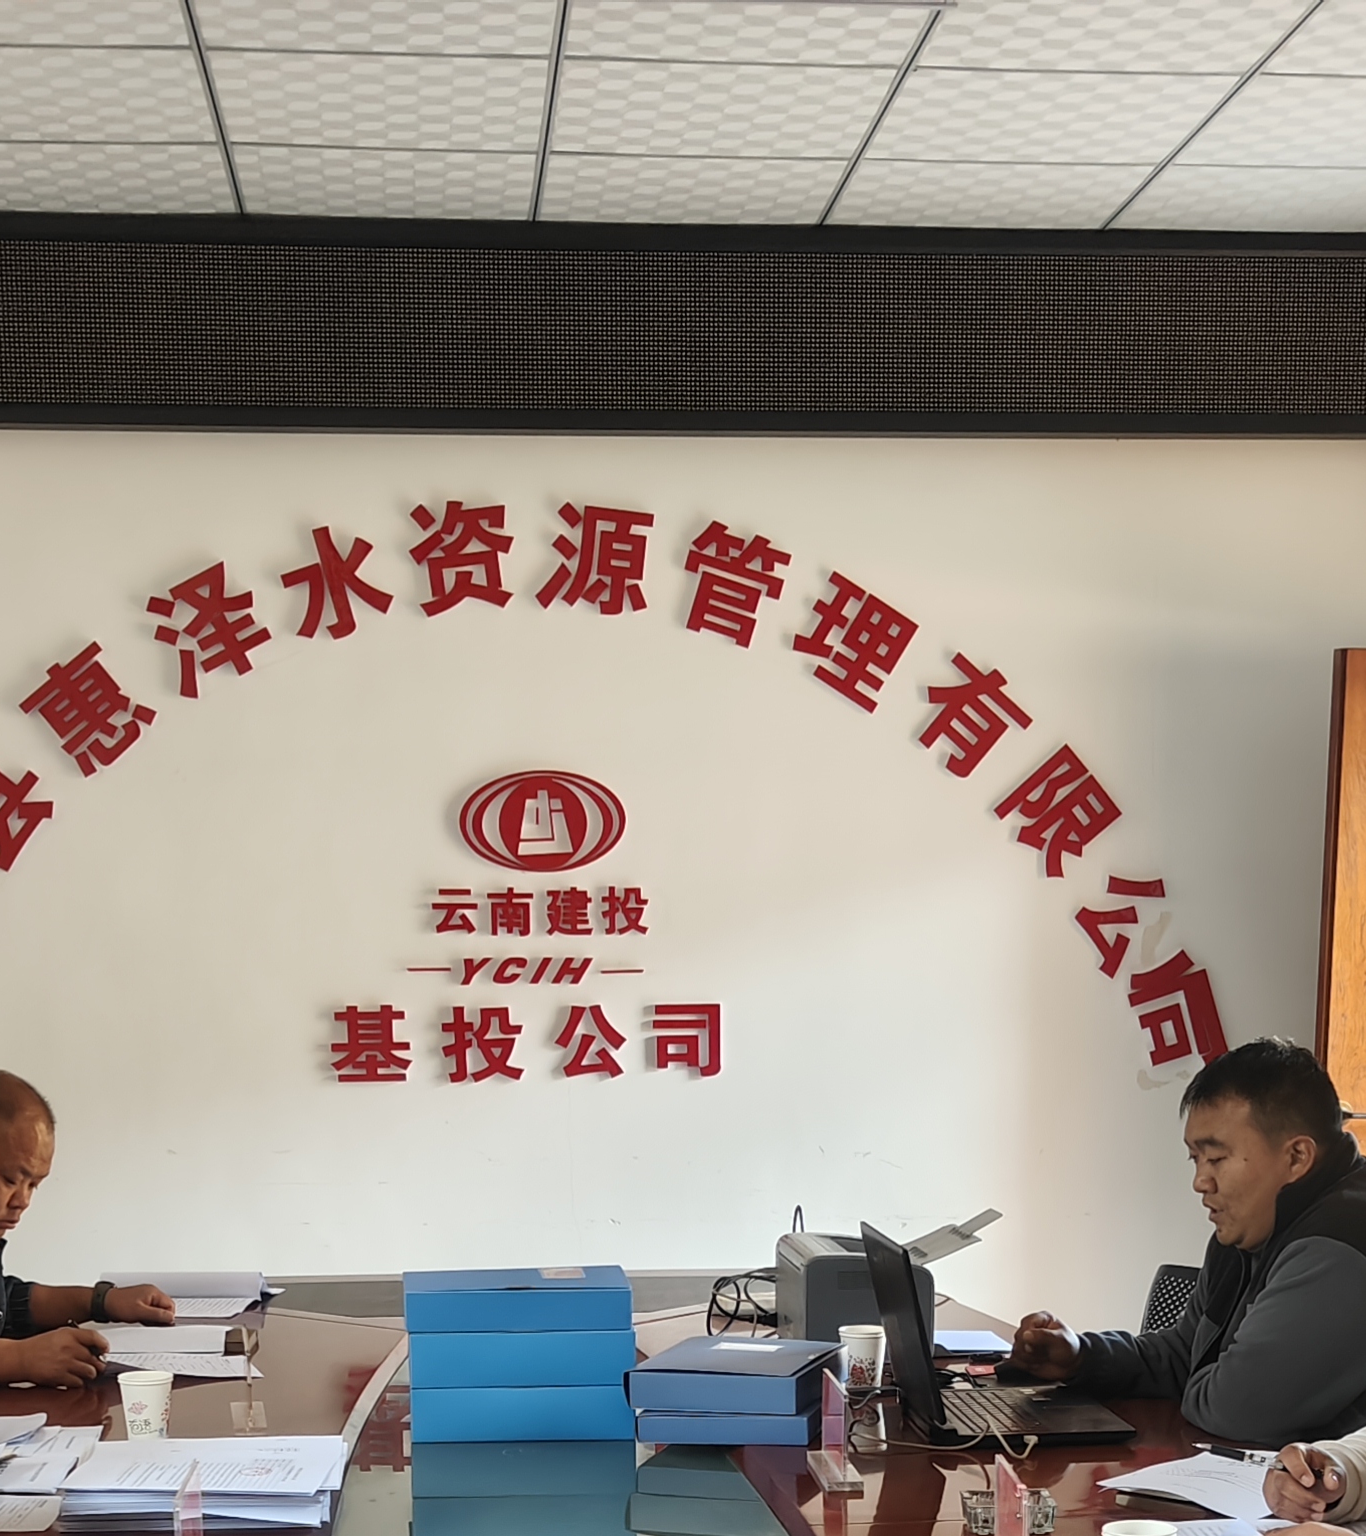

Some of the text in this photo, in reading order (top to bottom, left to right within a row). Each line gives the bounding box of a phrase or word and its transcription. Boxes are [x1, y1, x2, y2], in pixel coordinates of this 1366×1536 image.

[432, 886, 649, 936] 云南建投
[460, 957, 593, 985] YCIH
[330, 1003, 724, 1084] 基投公司
